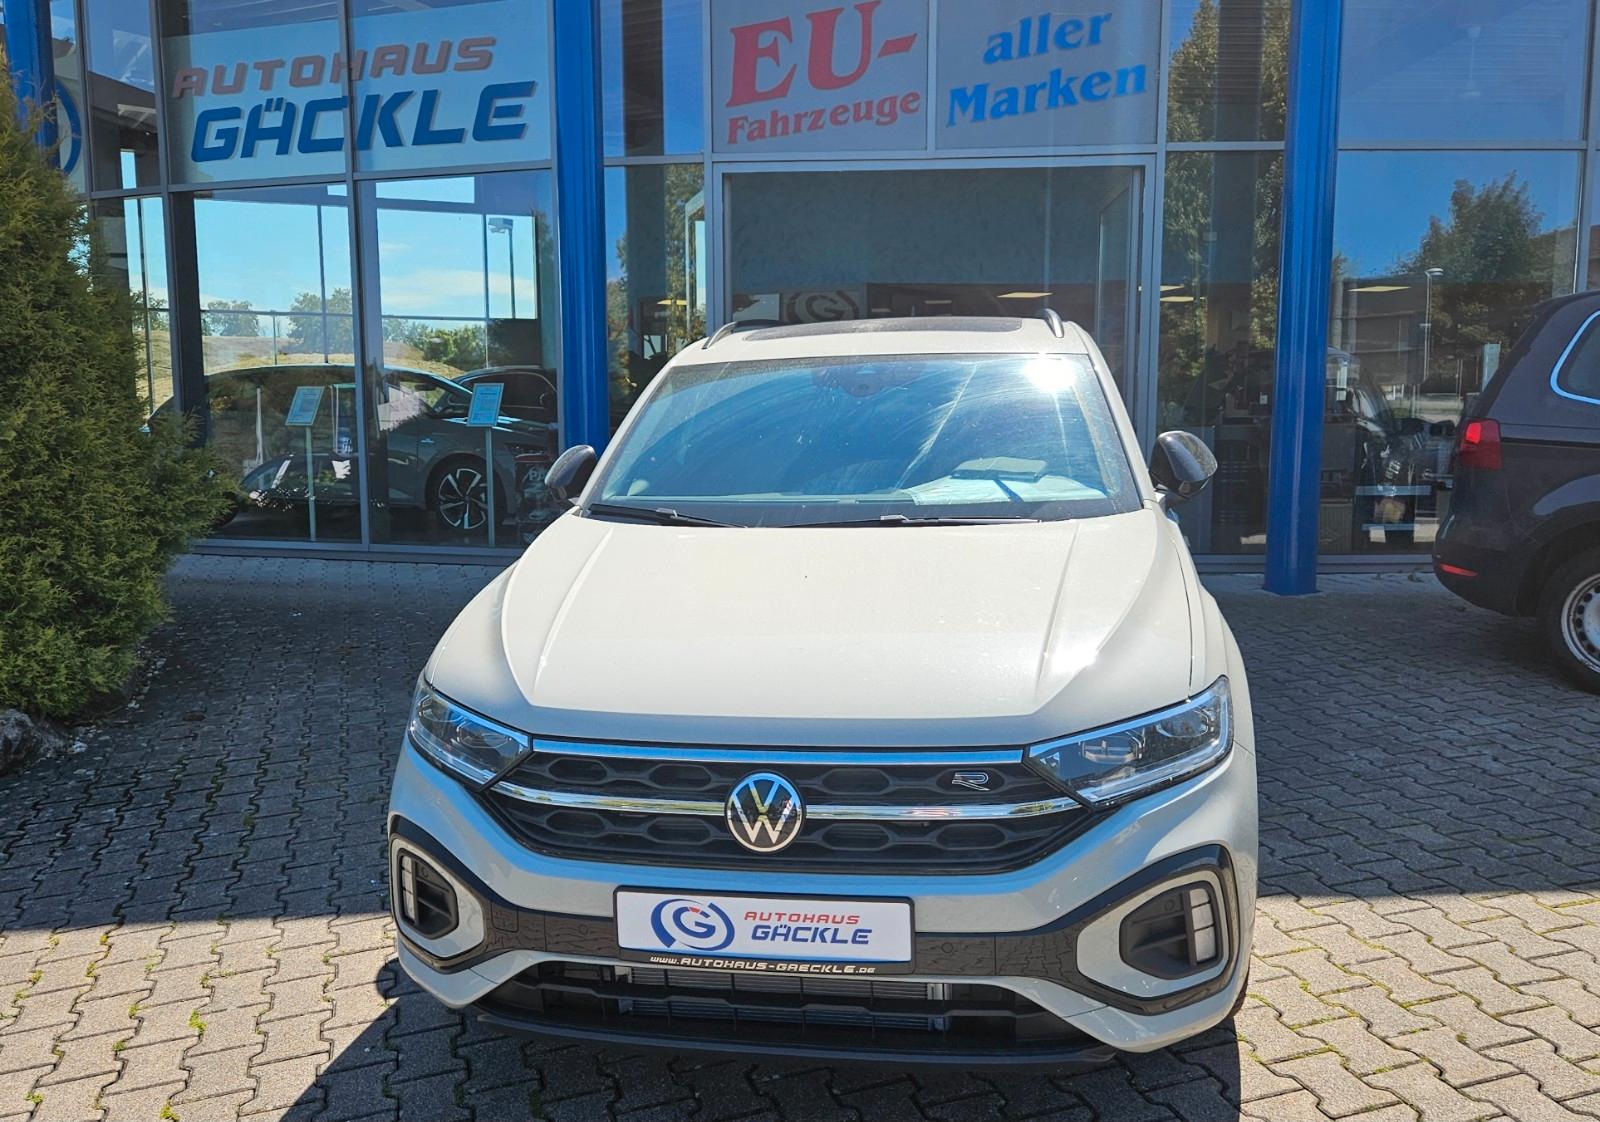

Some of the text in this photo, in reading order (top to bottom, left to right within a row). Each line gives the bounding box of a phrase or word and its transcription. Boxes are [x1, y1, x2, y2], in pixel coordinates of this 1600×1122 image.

[171, 36, 497, 99] AUTOHAUS
[726, 0, 918, 107] EU-
[983, 12, 1112, 65] aller
[191, 80, 536, 163] GÄCKLE
[727, 91, 921, 145] Fahrzeuge
[945, 63, 1147, 128] Marken
[744, 911, 860, 925] AUTOHAUS
[751, 924, 873, 945] GÄCKLE
